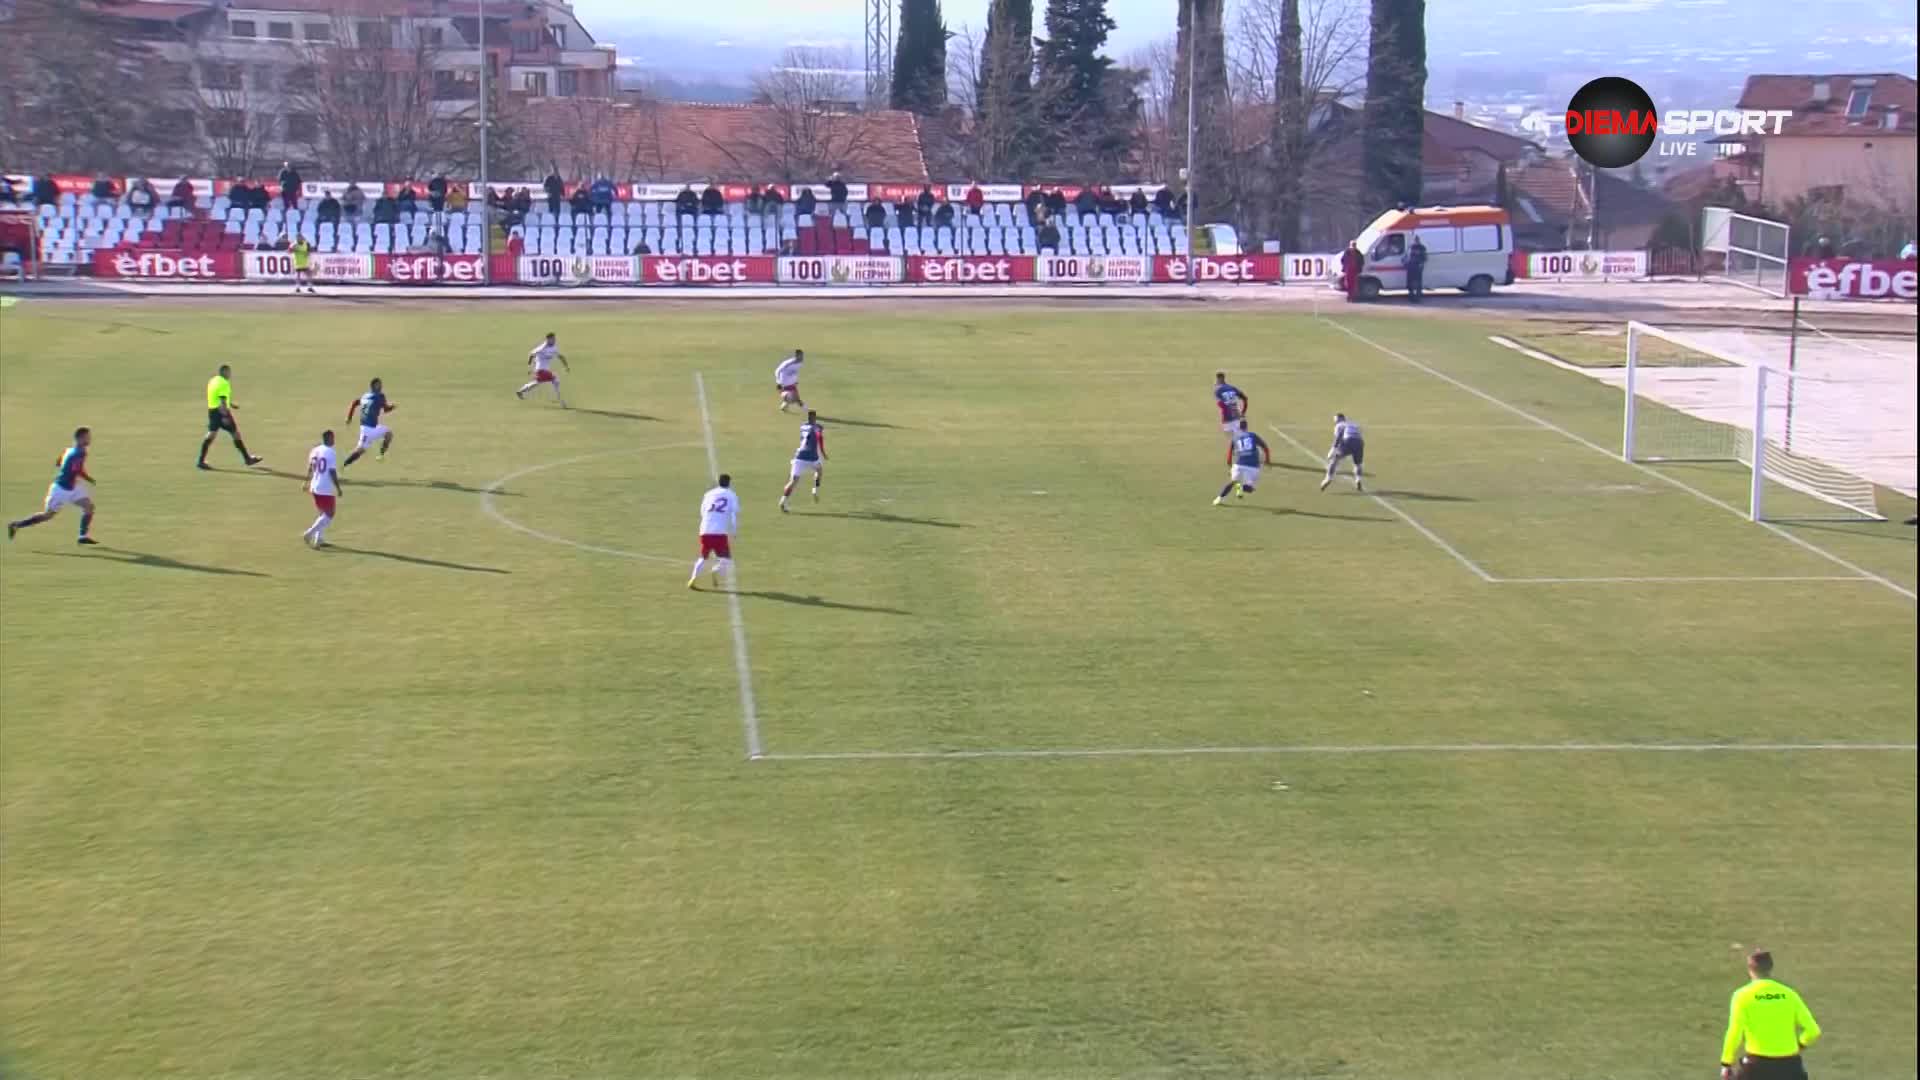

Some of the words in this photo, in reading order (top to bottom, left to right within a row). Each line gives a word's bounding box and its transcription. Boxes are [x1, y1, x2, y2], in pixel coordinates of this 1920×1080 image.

[113, 253, 216, 276] efbet
[256, 255, 291, 275] 100
[389, 257, 485, 280] efbet
[531, 259, 563, 278] 100
[656, 258, 747, 281] efbet
[788, 260, 822, 280] 100
[921, 258, 1010, 281] efbet
[1047, 259, 1078, 278] 100
[1165, 257, 1254, 280] efbet
[1294, 258, 1324, 276] 100
[1541, 255, 1573, 274] 100
